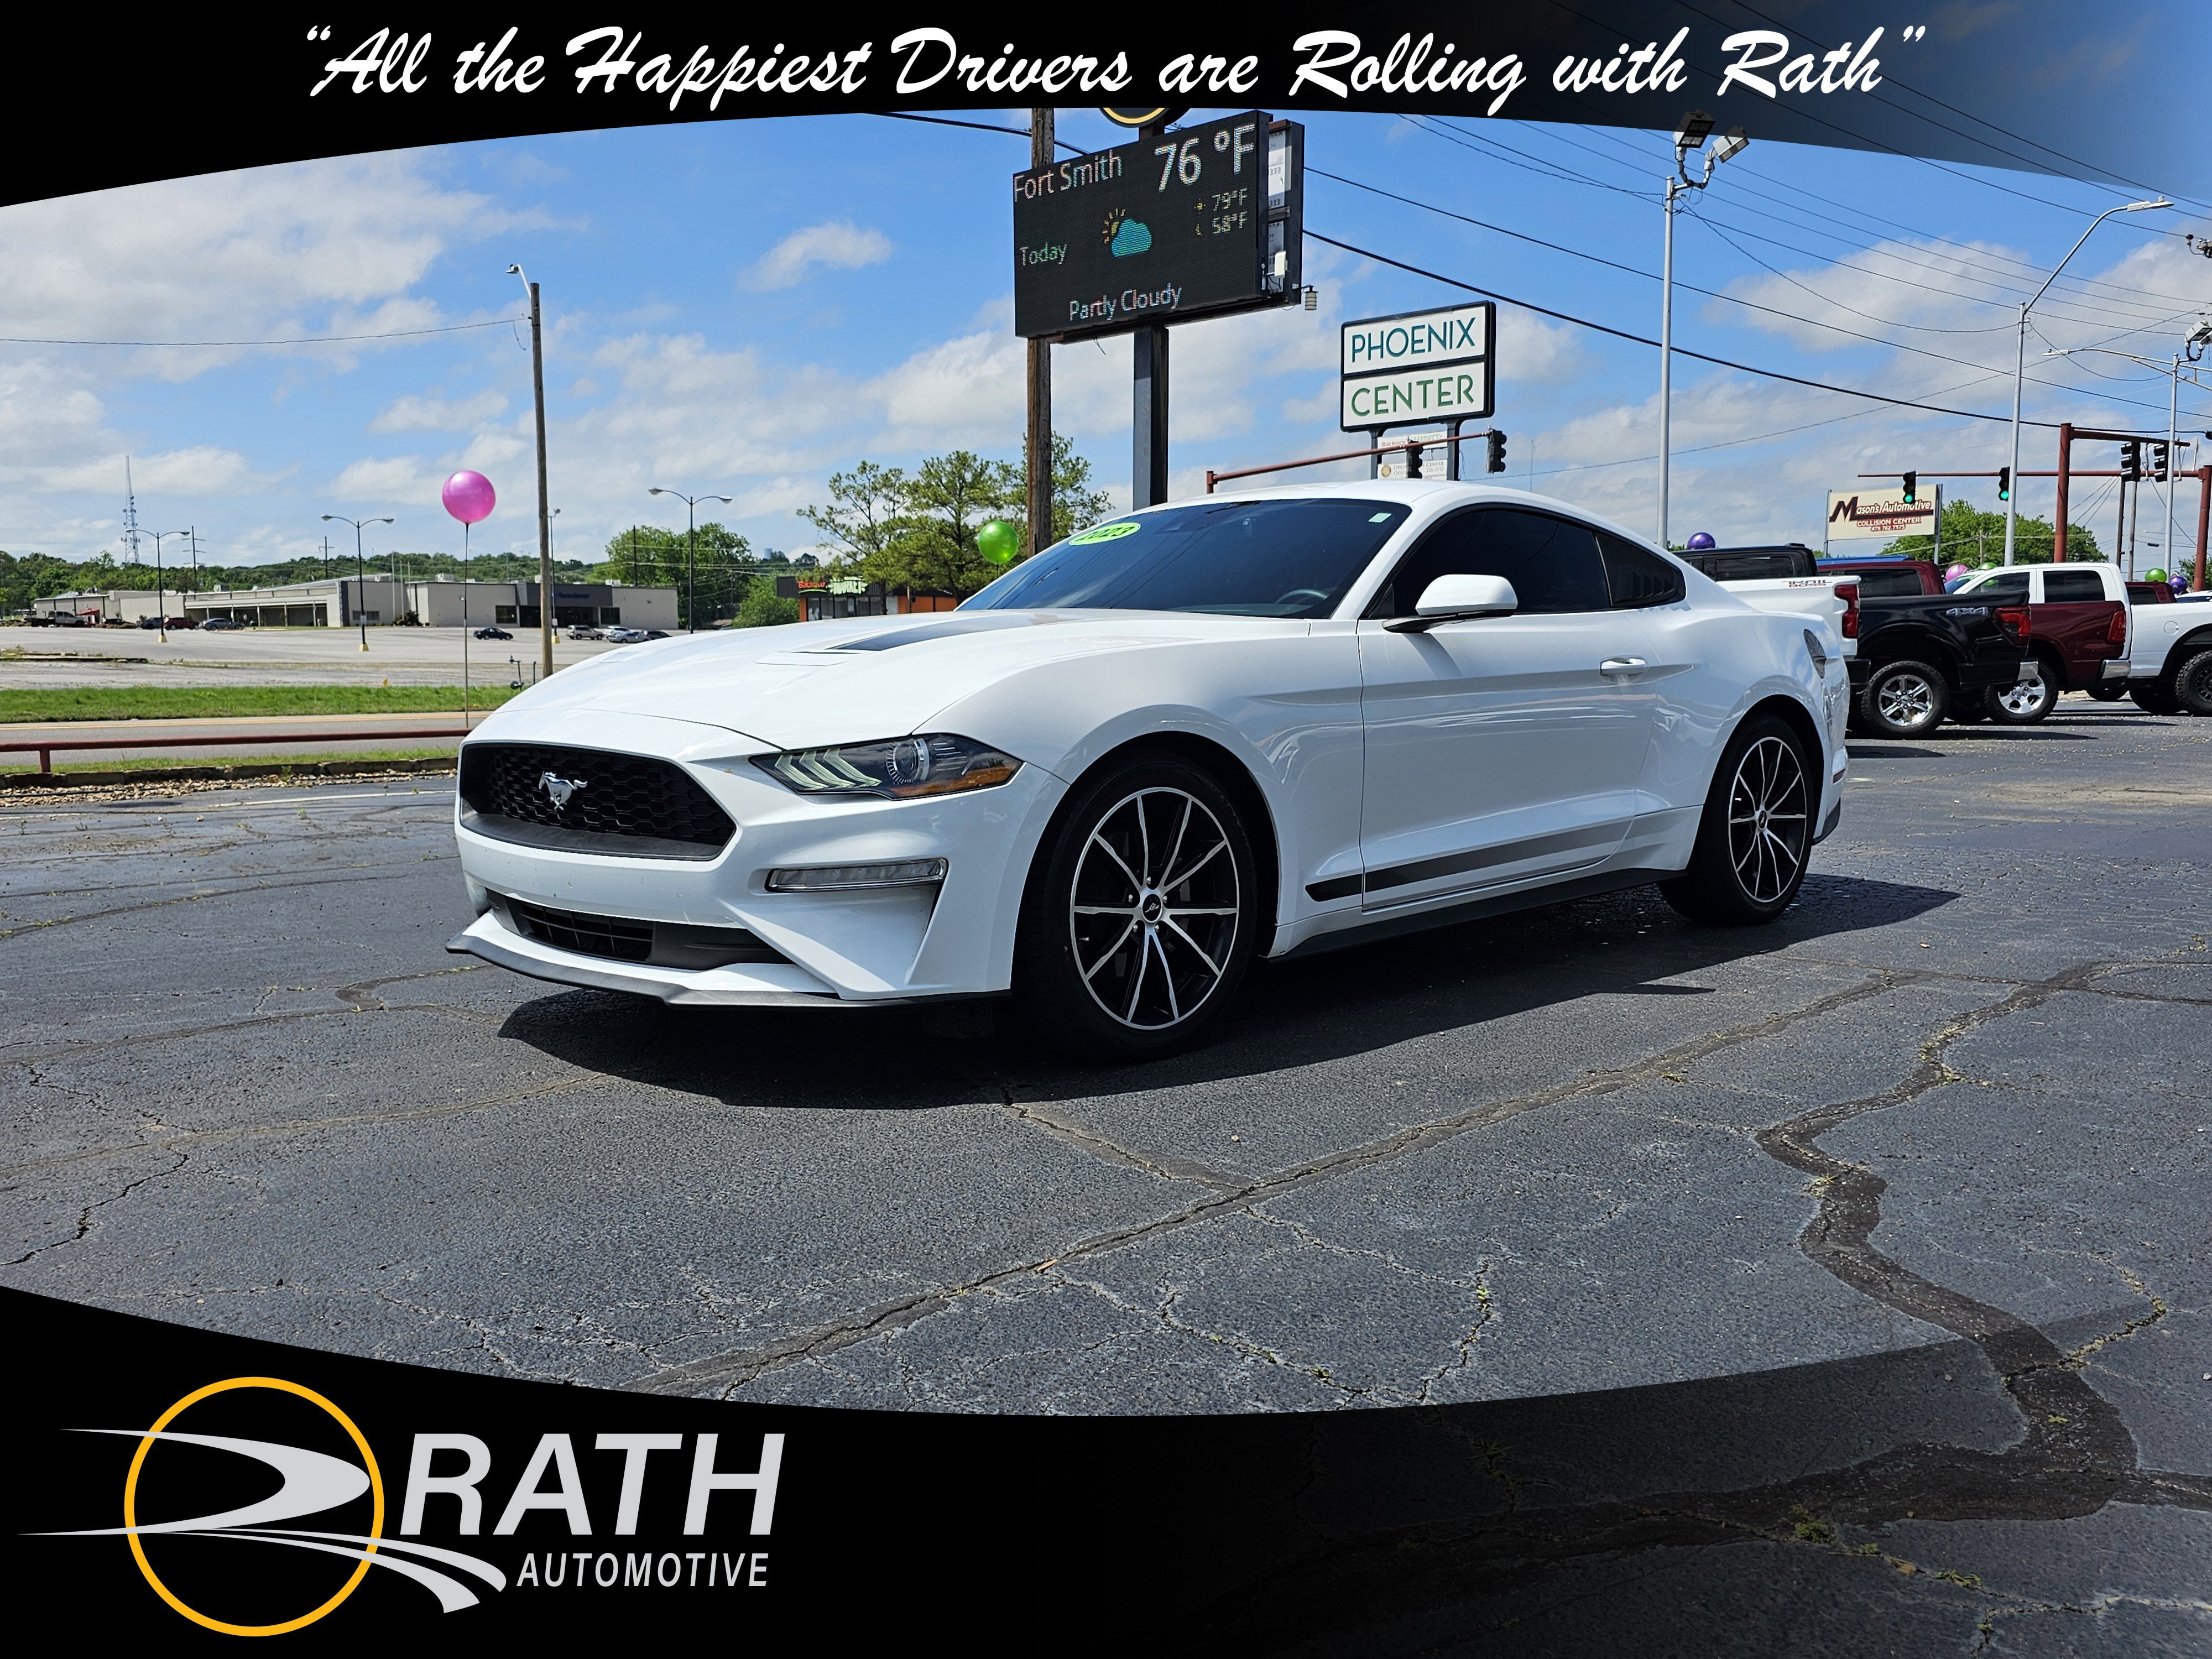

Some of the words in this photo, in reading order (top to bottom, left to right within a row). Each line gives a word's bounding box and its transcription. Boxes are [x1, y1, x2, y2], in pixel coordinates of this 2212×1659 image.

[1013, 170, 1054, 202] Fort
[1060, 149, 1121, 191] Smith
[1154, 137, 1202, 192] 76
[1020, 242, 1067, 265] Today
[1070, 295, 1117, 321] Partly
[1120, 283, 1182, 311] Cloudy
[1352, 317, 1476, 363] PHOENIX
[1351, 374, 1474, 417] CENTER
[1829, 496, 1881, 522] Mason's
[1882, 499, 1932, 514] Automotive
[1856, 518, 1891, 527] COLLISION
[1892, 515, 1921, 525] CENTER
